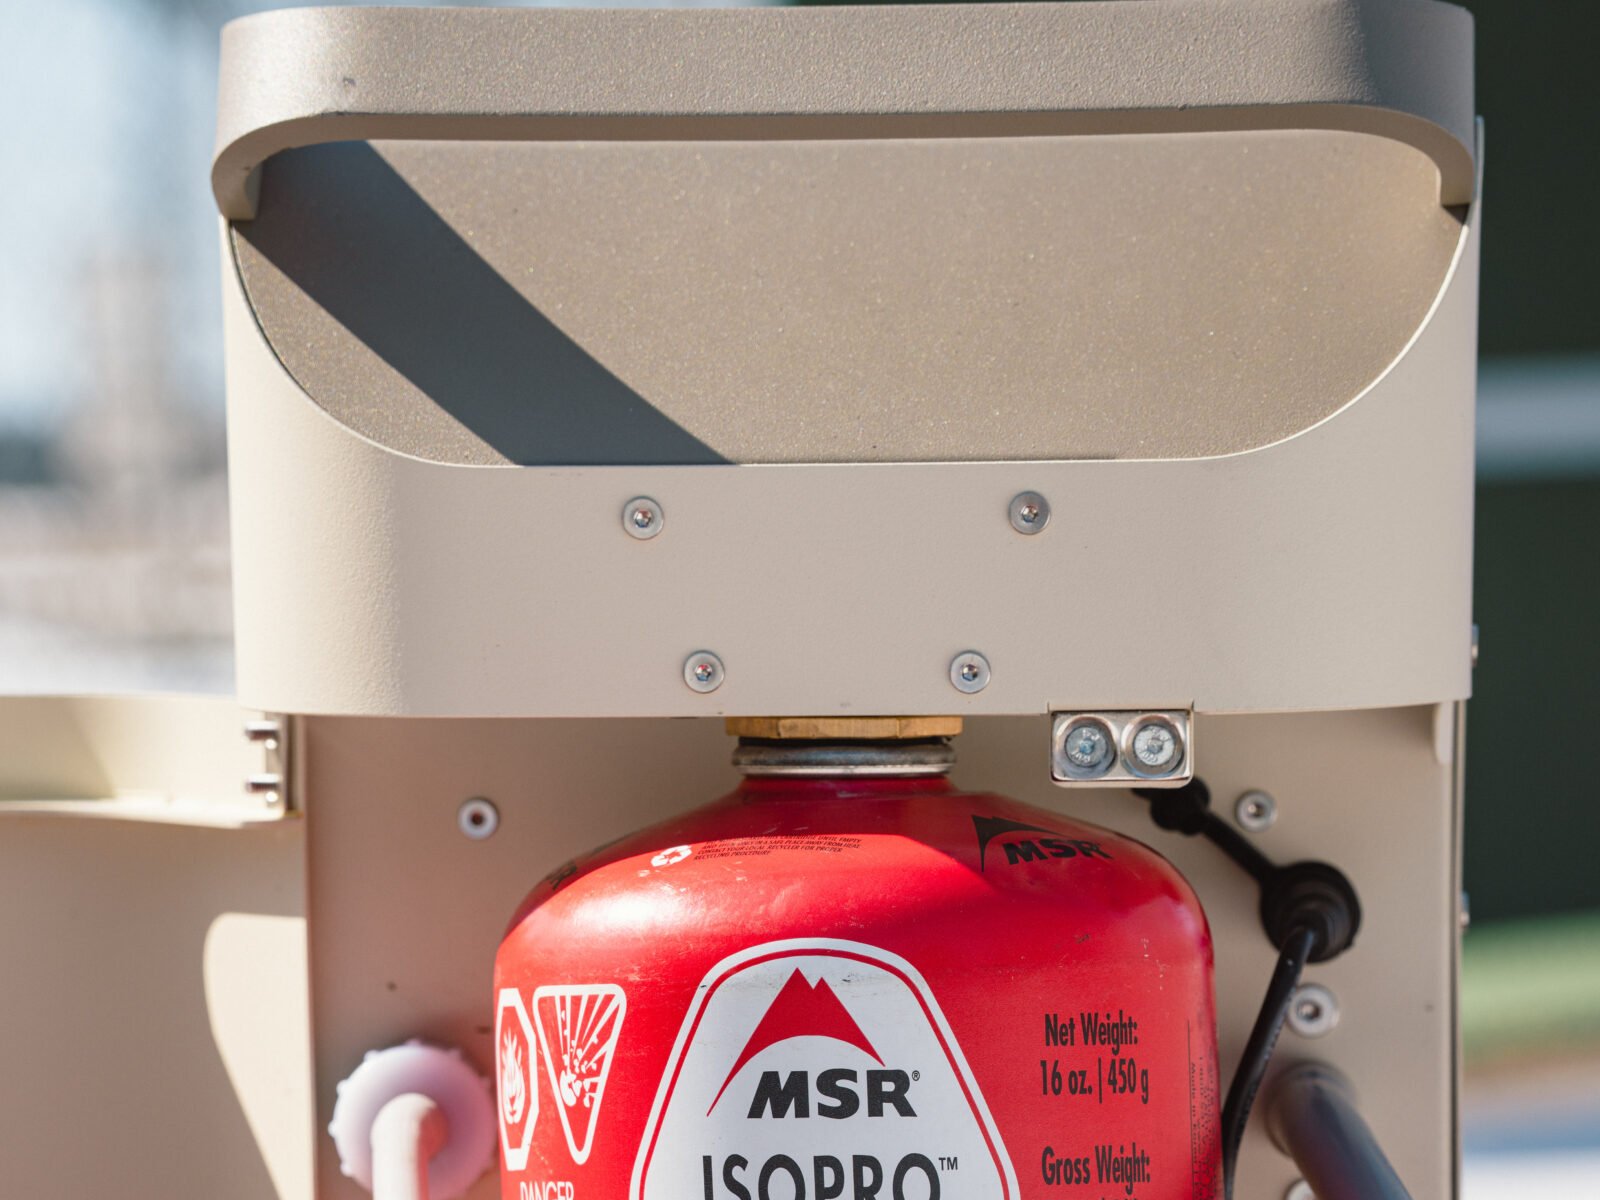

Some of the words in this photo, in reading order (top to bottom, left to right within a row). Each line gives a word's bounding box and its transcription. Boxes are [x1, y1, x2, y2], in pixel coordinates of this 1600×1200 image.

[694, 851, 729, 860] RECYCLING
[1002, 838, 1113, 865] MSR
[1045, 1013, 1076, 1047] Net
[1080, 1010, 1138, 1055] Weight:
[1040, 1059, 1063, 1096] 16
[1068, 1069, 1092, 1096] oz.
[1107, 1058, 1137, 1095] 450
[1140, 1073, 1149, 1104] g
[1041, 1145, 1090, 1186] Gross
[1095, 1143, 1151, 1196] Weight:
